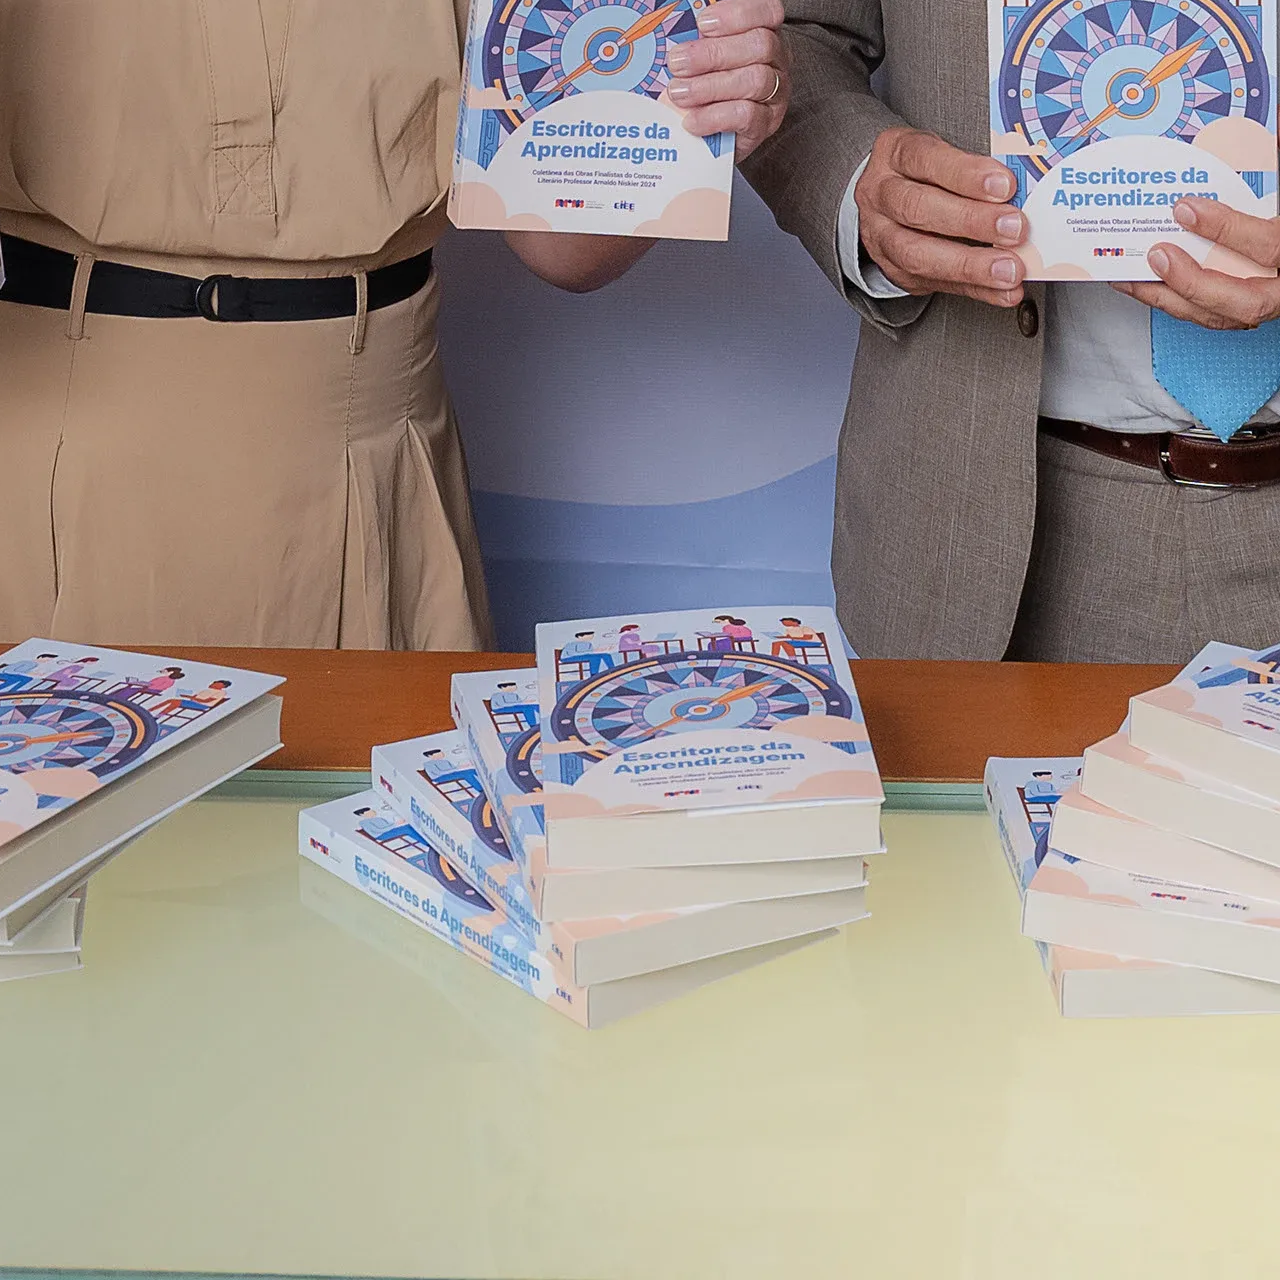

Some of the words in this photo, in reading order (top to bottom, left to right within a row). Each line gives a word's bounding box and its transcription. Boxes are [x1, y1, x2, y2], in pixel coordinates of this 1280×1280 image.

[532, 120, 640, 140] Escritores
[644, 122, 670, 140] da
[521, 141, 678, 164] Aprendizagem
[634, 172, 662, 180] Concurso
[1061, 167, 1176, 184] Escritores
[1181, 167, 1209, 184] da
[1052, 188, 1218, 210] Aprendizag
[614, 752, 806, 774] Aprendizagem
[622, 744, 755, 762] Escritores
[761, 742, 792, 752] da
[410, 796, 456, 852] Escritores
[456, 844, 469, 865] da
[470, 856, 541, 935] Aprendizagem
[355, 855, 419, 908] Escritores
[422, 898, 438, 918] da
[440, 908, 540, 981] Aprendizagem
